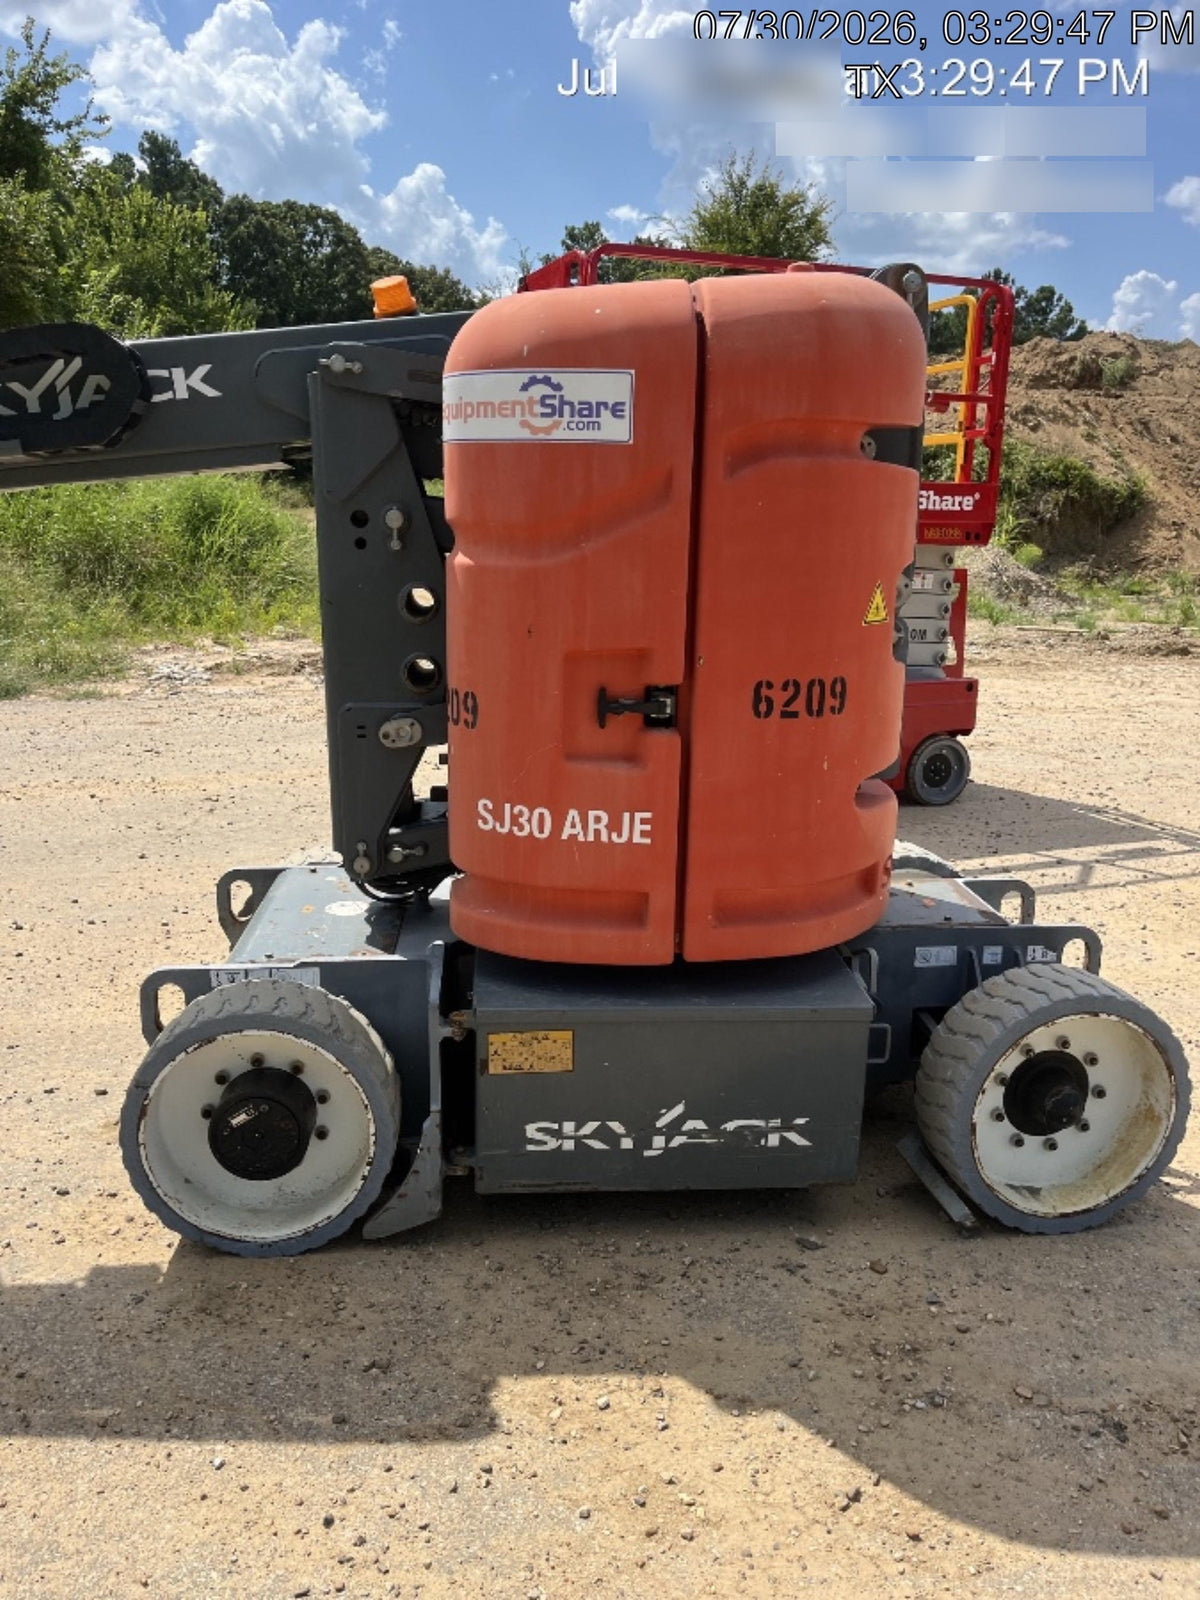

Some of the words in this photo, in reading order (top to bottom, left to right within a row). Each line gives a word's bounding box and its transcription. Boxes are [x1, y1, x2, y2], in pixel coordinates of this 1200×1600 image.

[442, 394, 627, 425] quipmentShare
[447, 687, 479, 730] 09
[752, 675, 848, 720] 6209
[476, 798, 552, 840] SJ30
[561, 808, 654, 846] ARJE
